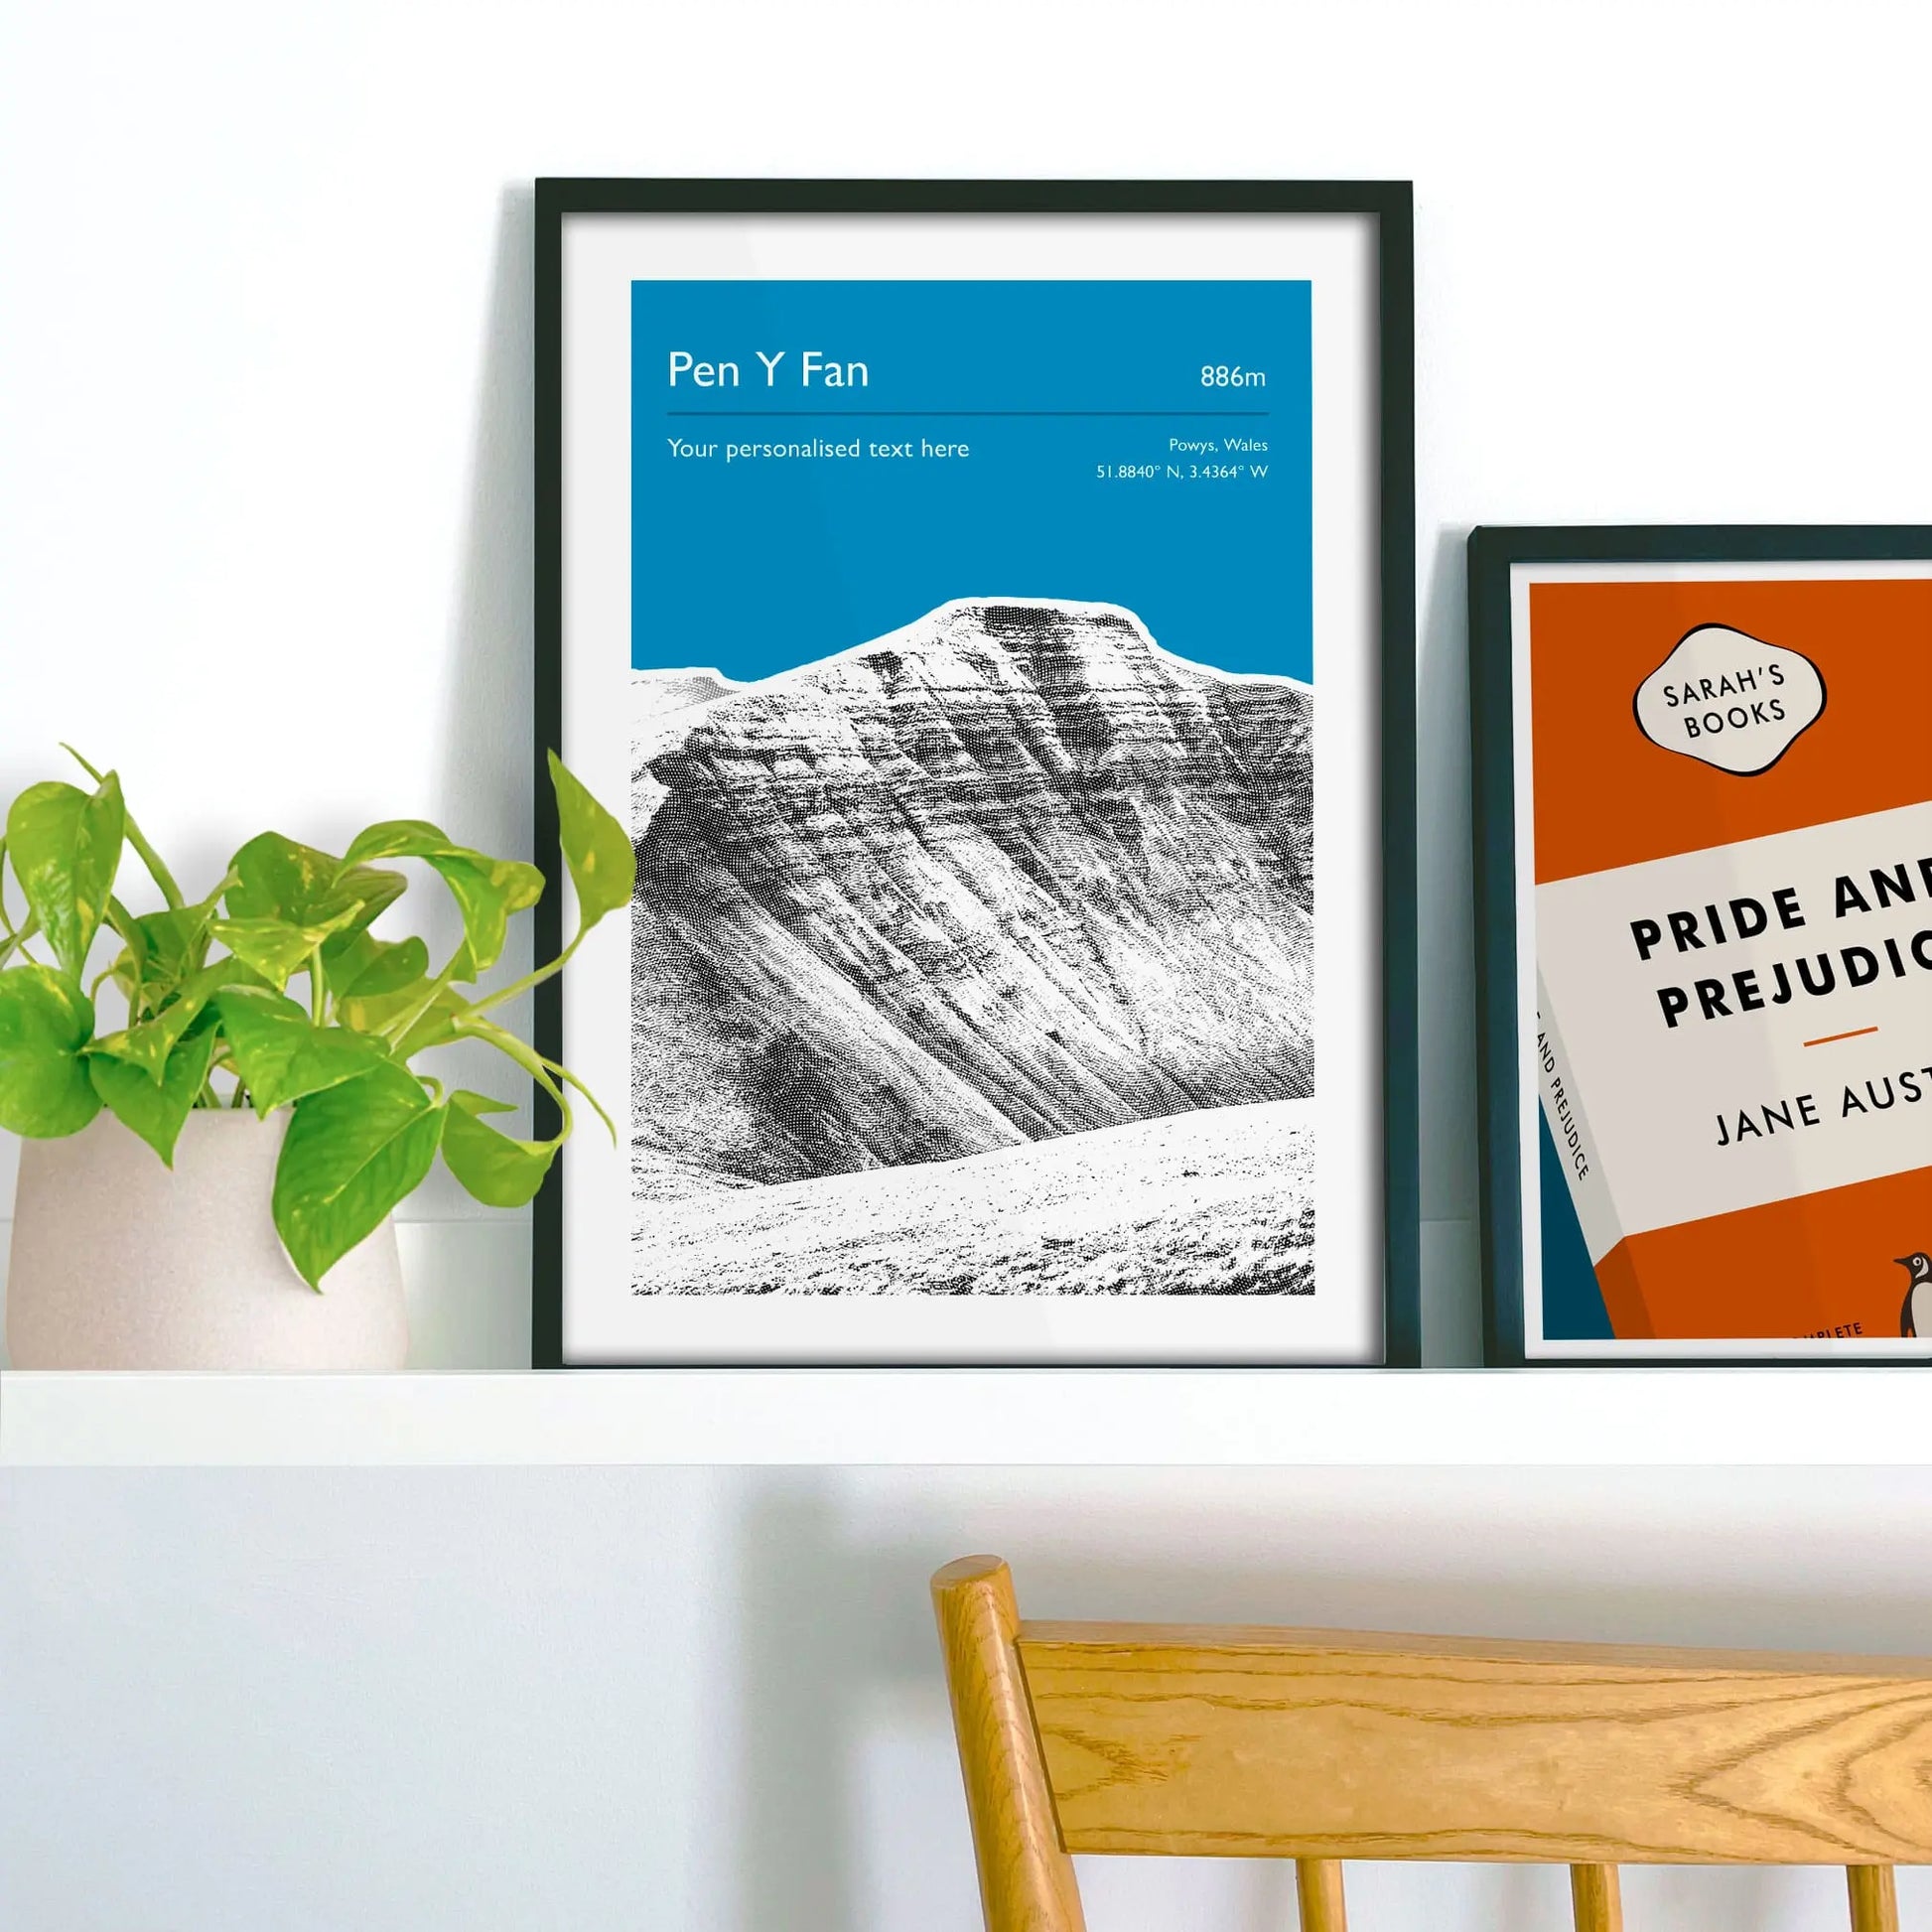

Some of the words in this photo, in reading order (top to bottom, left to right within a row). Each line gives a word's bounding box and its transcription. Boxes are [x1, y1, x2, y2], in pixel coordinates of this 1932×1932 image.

[669, 350, 740, 387] Pen
[755, 350, 786, 387] Y
[802, 350, 869, 387] Fan
[1200, 364, 1266, 387] 886m
[667, 438, 719, 458] Your
[726, 438, 860, 464] personalised
[869, 441, 913, 458] text
[921, 438, 970, 458] here
[1170, 438, 1218, 456] Powys,
[1223, 438, 1268, 453] Wales
[1097, 465, 1161, 480] 51.8840°
[1167, 465, 1185, 481] N,
[1189, 465, 1243, 480] 3.4364°
[1249, 465, 1269, 479] W
[1663, 663, 1786, 708] SARAH'S
[1683, 698, 1786, 739] BOOKS
[1629, 887, 1806, 961] PRIDE
[1537, 1032, 1556, 1073] AND
[1550, 1076, 1589, 1181] PREJUDICE
[1717, 1094, 1821, 1147] JANE
